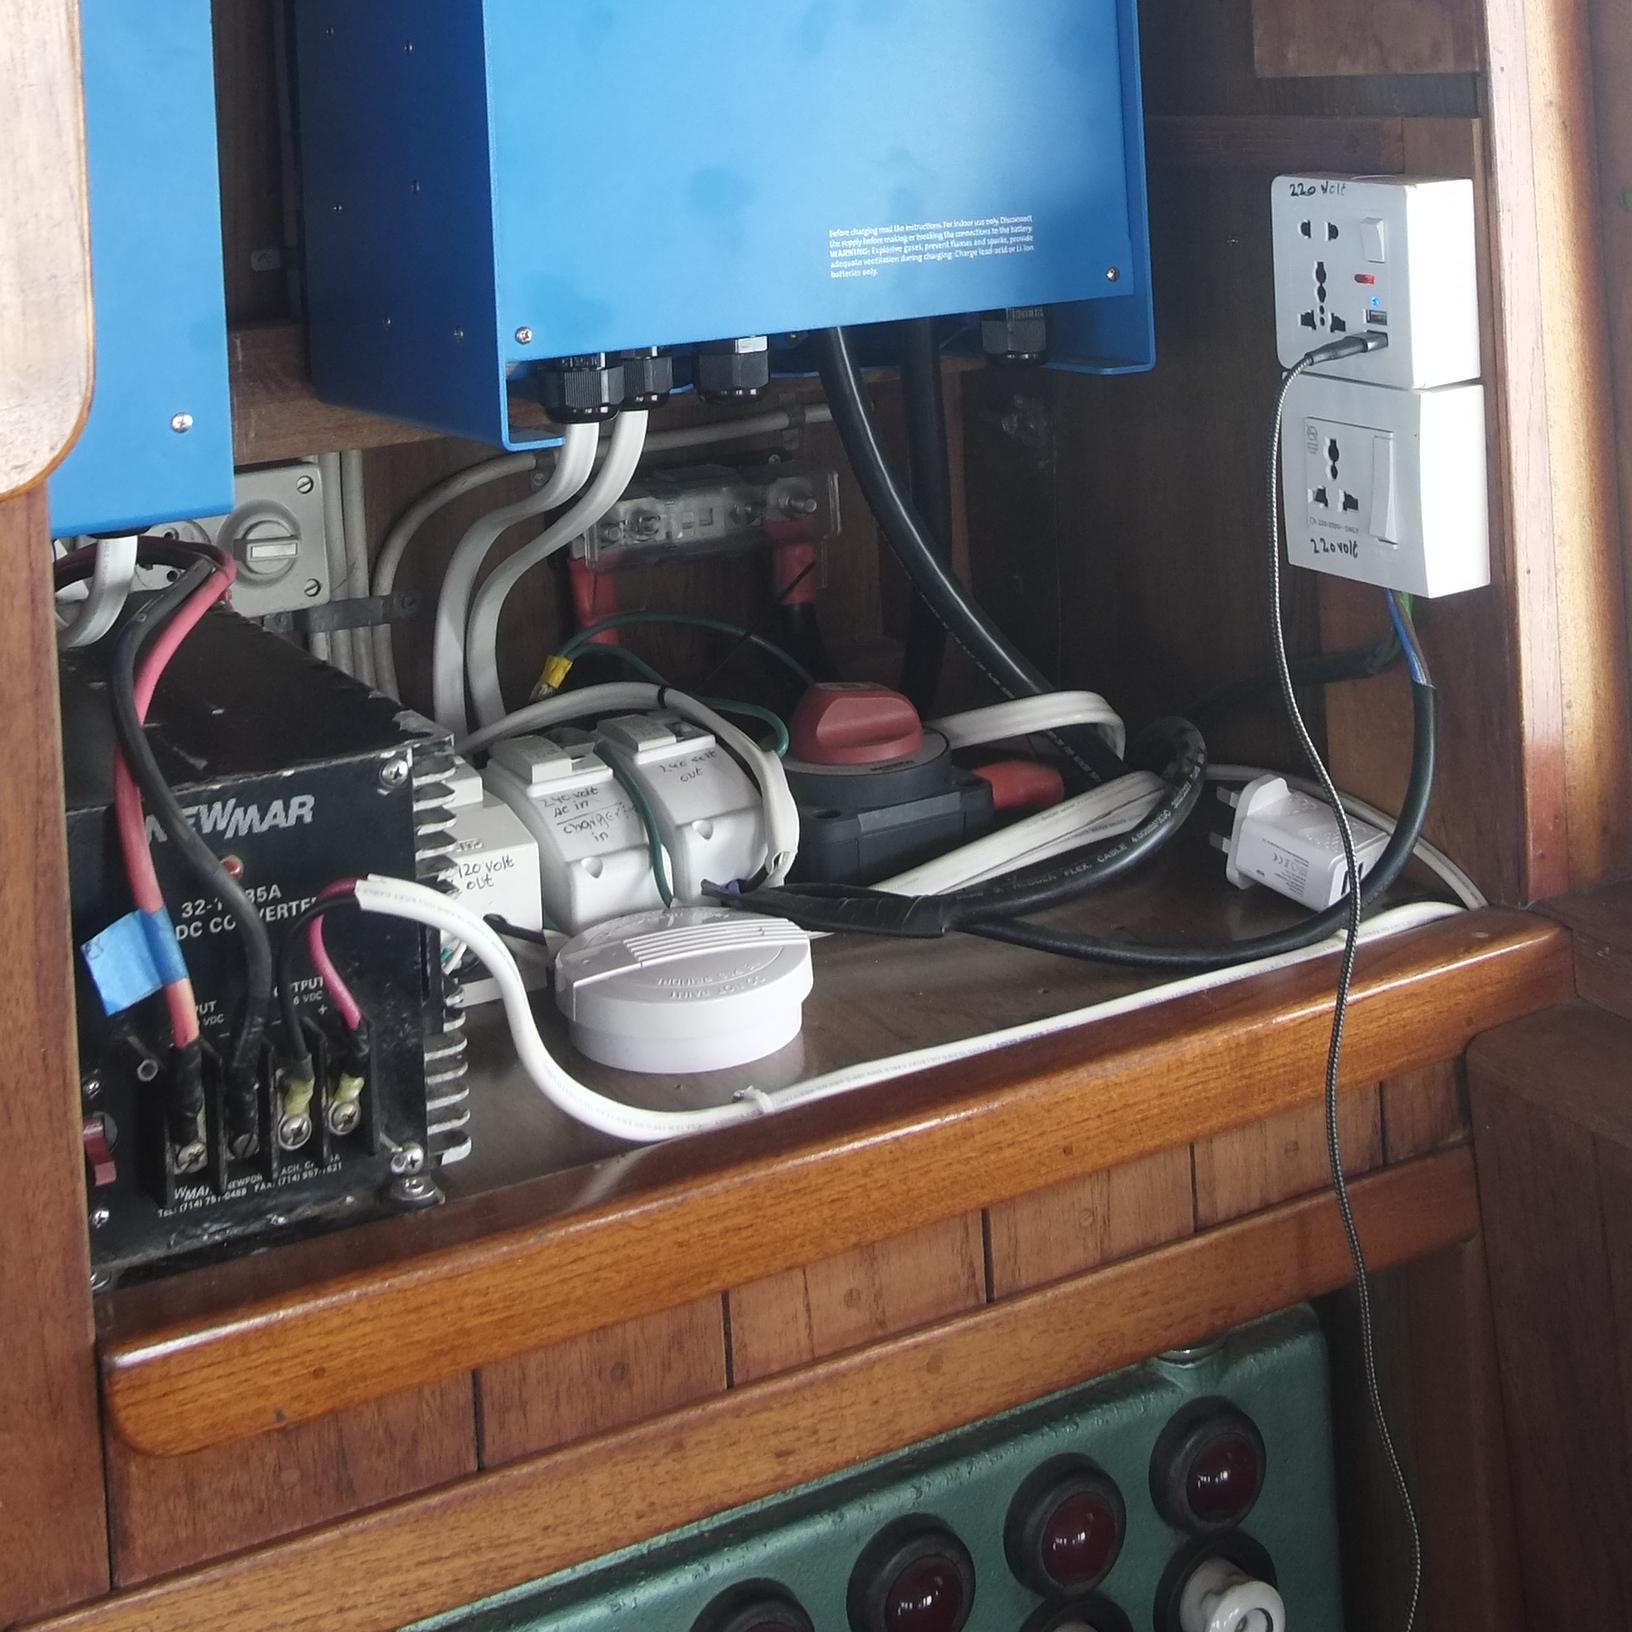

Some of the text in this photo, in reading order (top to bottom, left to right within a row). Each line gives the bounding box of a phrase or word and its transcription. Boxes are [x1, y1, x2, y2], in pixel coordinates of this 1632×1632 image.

[1289, 181, 1317, 197] 220
[1310, 537, 1336, 554] 220
[680, 767, 704, 783] out
[574, 799, 590, 811] in
[591, 831, 609, 842] in
[1096, 843, 1128, 863] CABLE
[458, 863, 482, 879] 120
